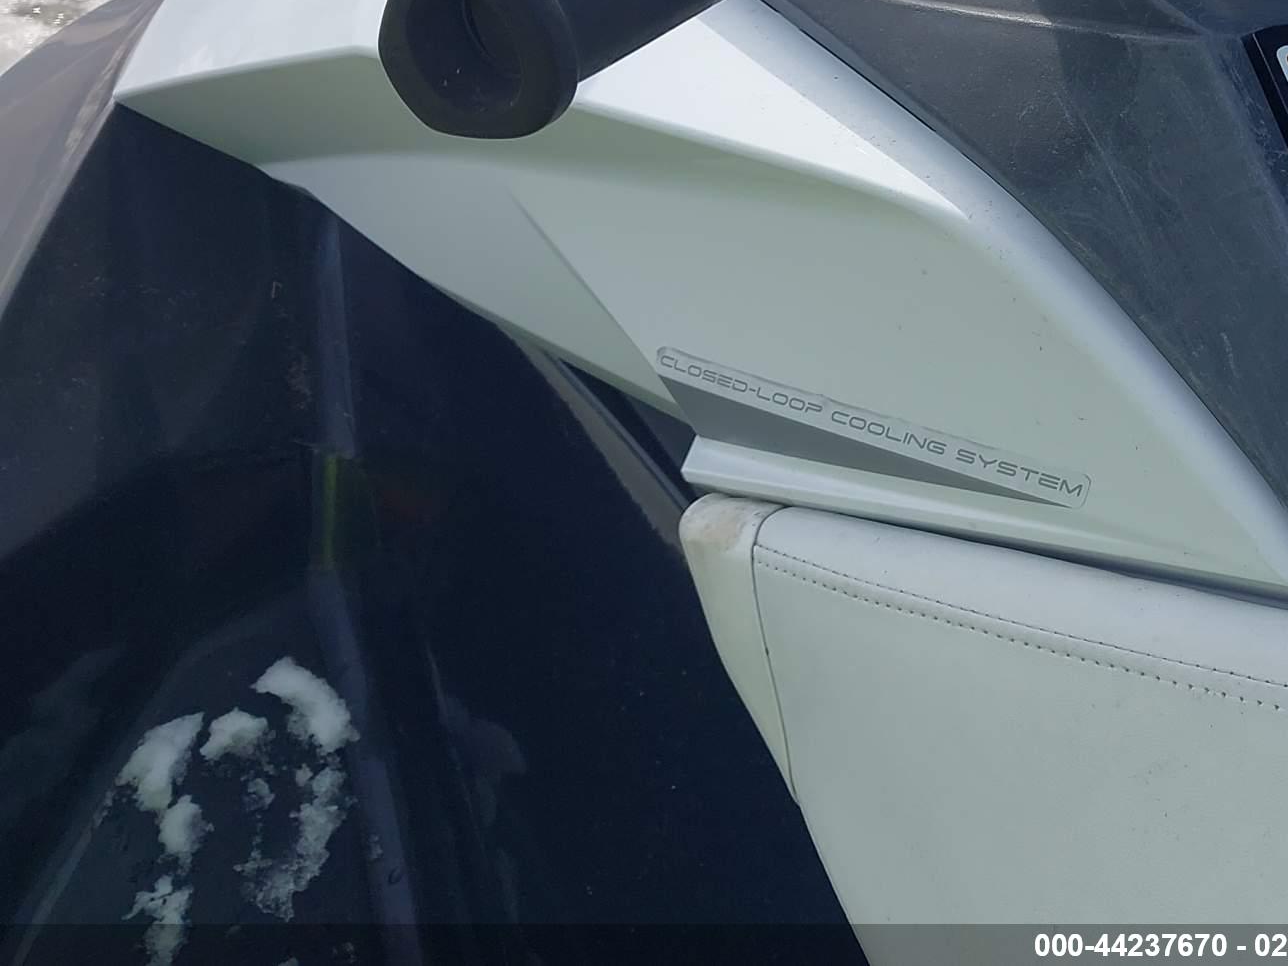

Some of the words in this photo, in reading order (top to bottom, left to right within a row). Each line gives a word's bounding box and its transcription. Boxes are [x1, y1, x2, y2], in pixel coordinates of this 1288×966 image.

[659, 353, 823, 413] CLOSED-LOOP
[831, 410, 947, 456] COOLING
[956, 448, 1085, 498] SYSTEM
